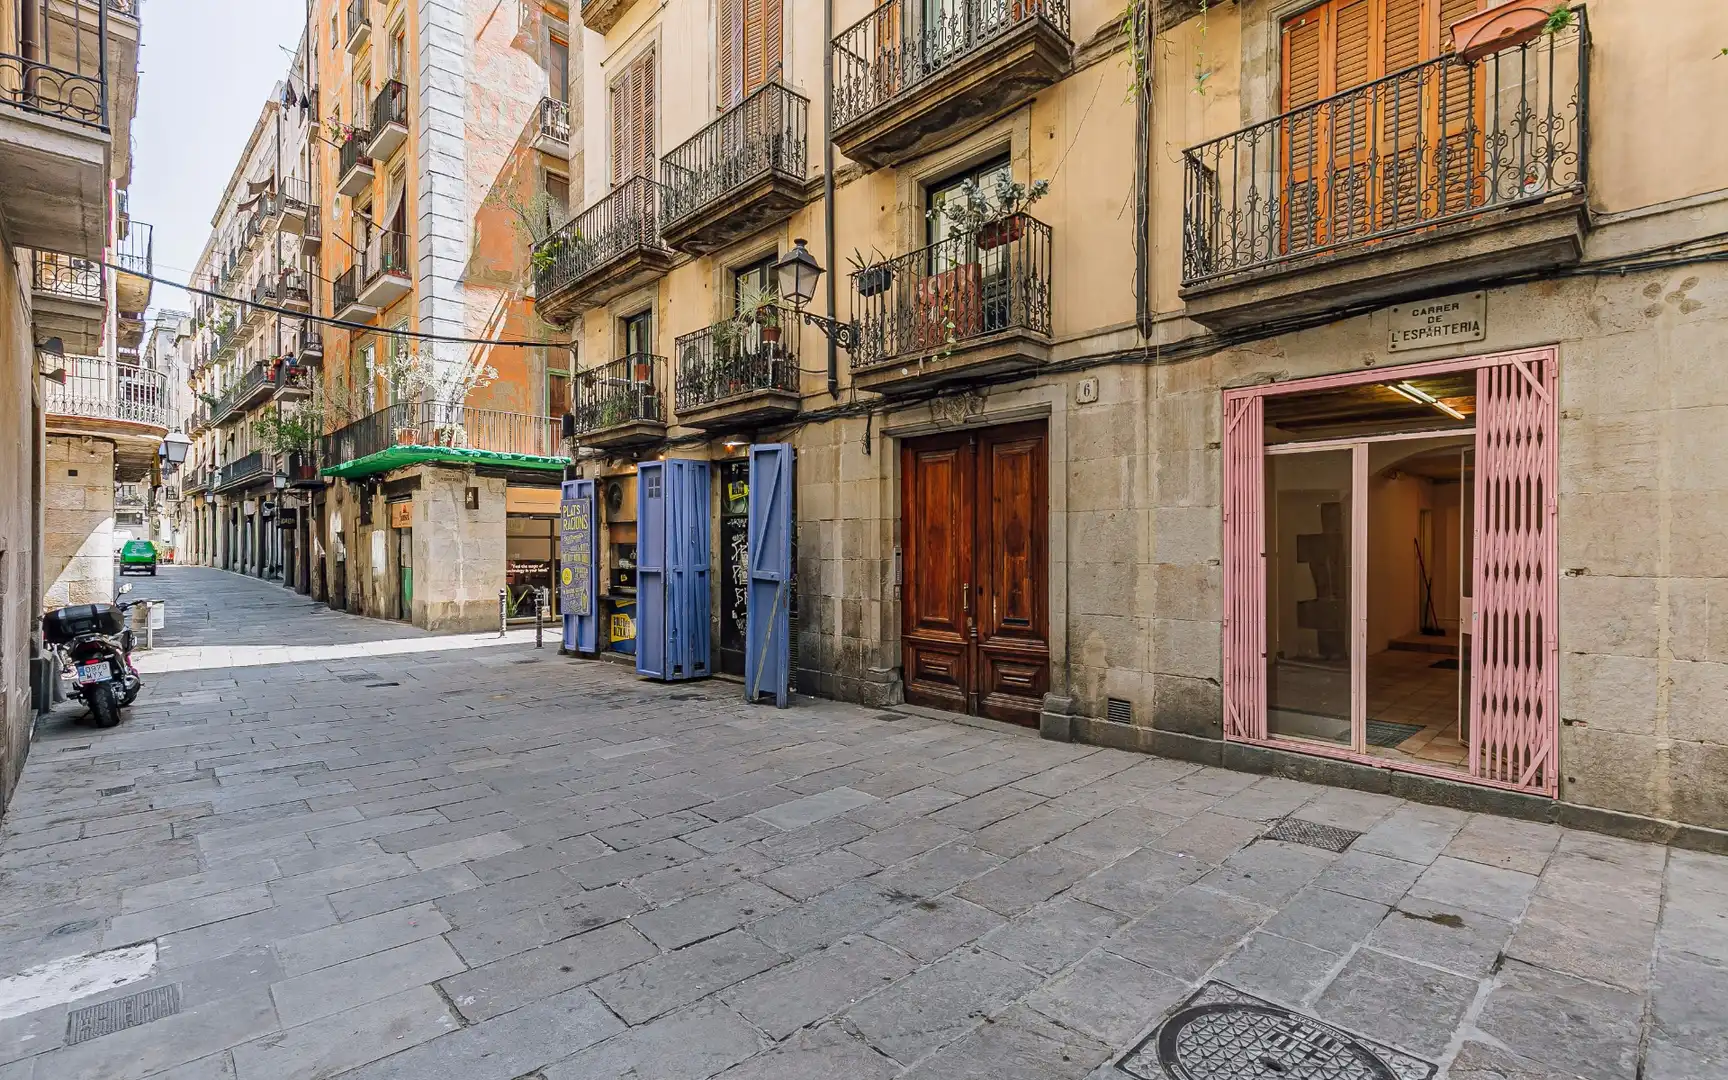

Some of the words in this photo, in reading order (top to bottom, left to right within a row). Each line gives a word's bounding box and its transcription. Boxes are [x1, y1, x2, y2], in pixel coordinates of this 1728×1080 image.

[1412, 302, 1460, 317] CARRER
[1427, 314, 1443, 324] DE
[1083, 382, 1091, 397] 6
